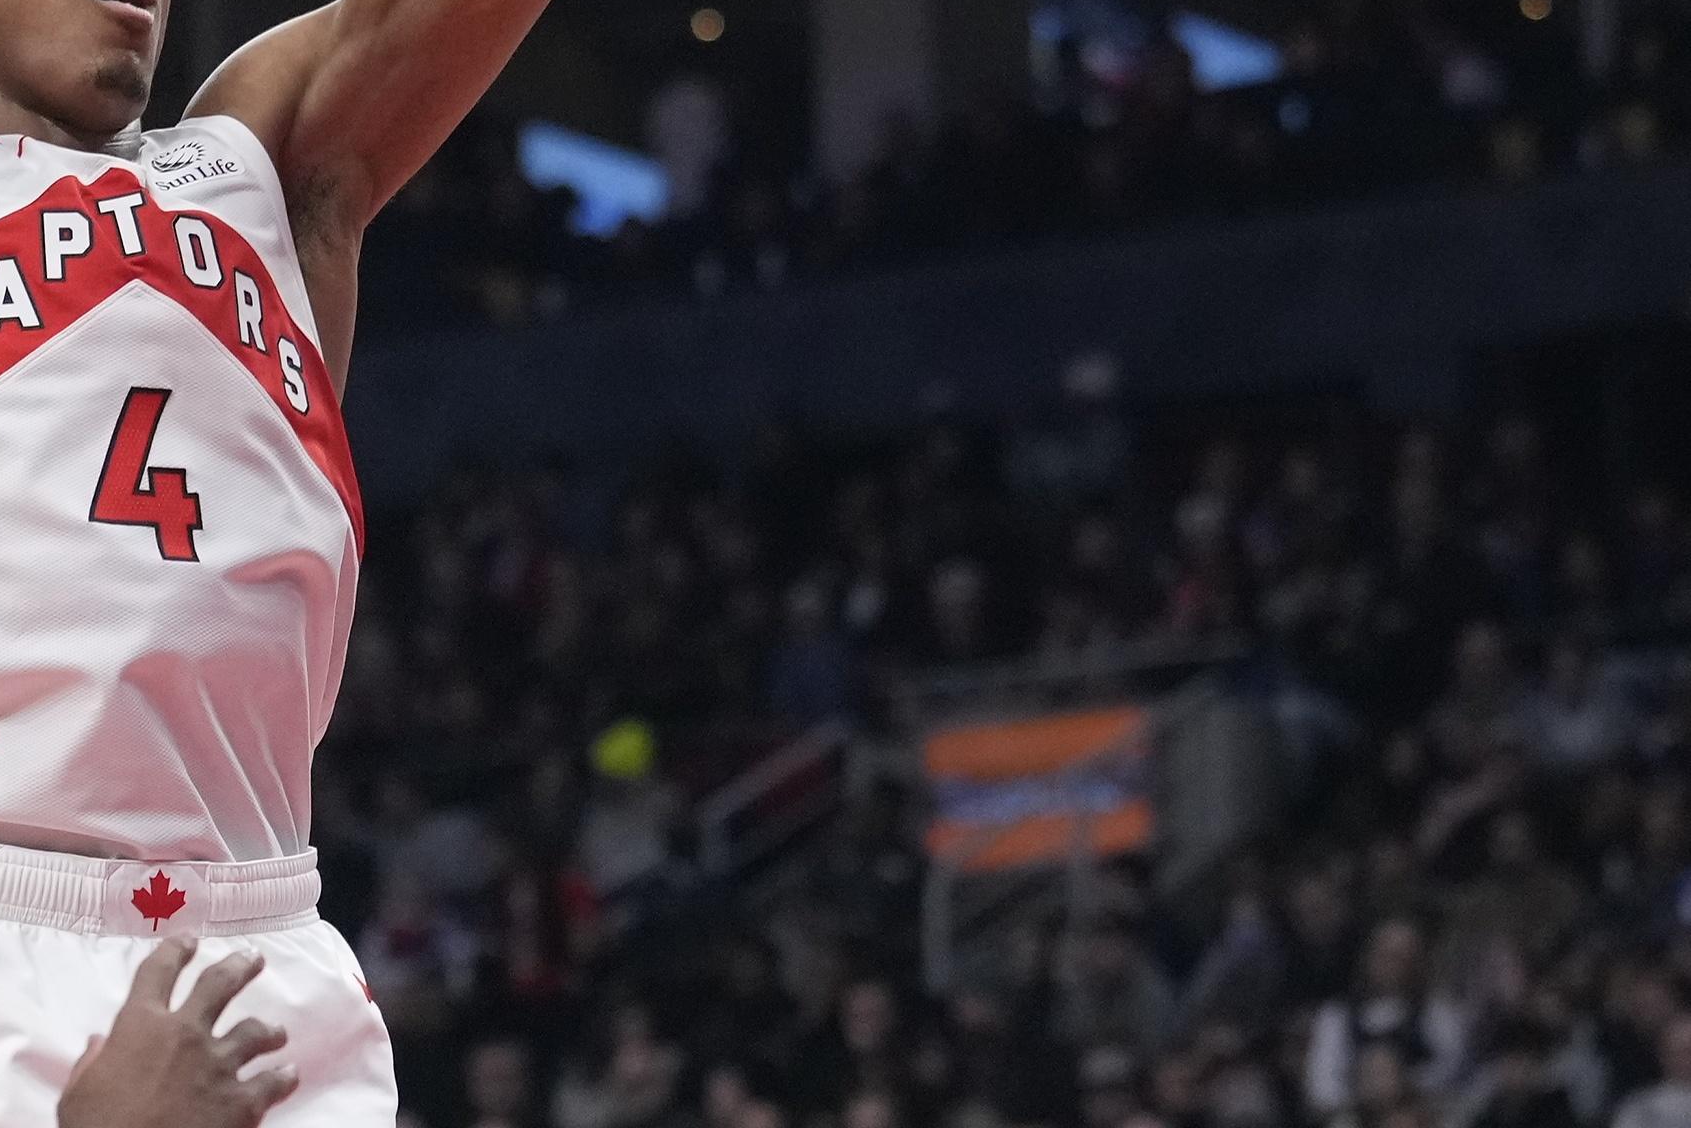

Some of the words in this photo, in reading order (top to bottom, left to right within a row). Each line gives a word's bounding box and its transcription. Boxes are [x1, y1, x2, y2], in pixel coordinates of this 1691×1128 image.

[155, 173, 197, 191] Sun
[196, 158, 238, 179] Life
[88, 386, 204, 563] 4
